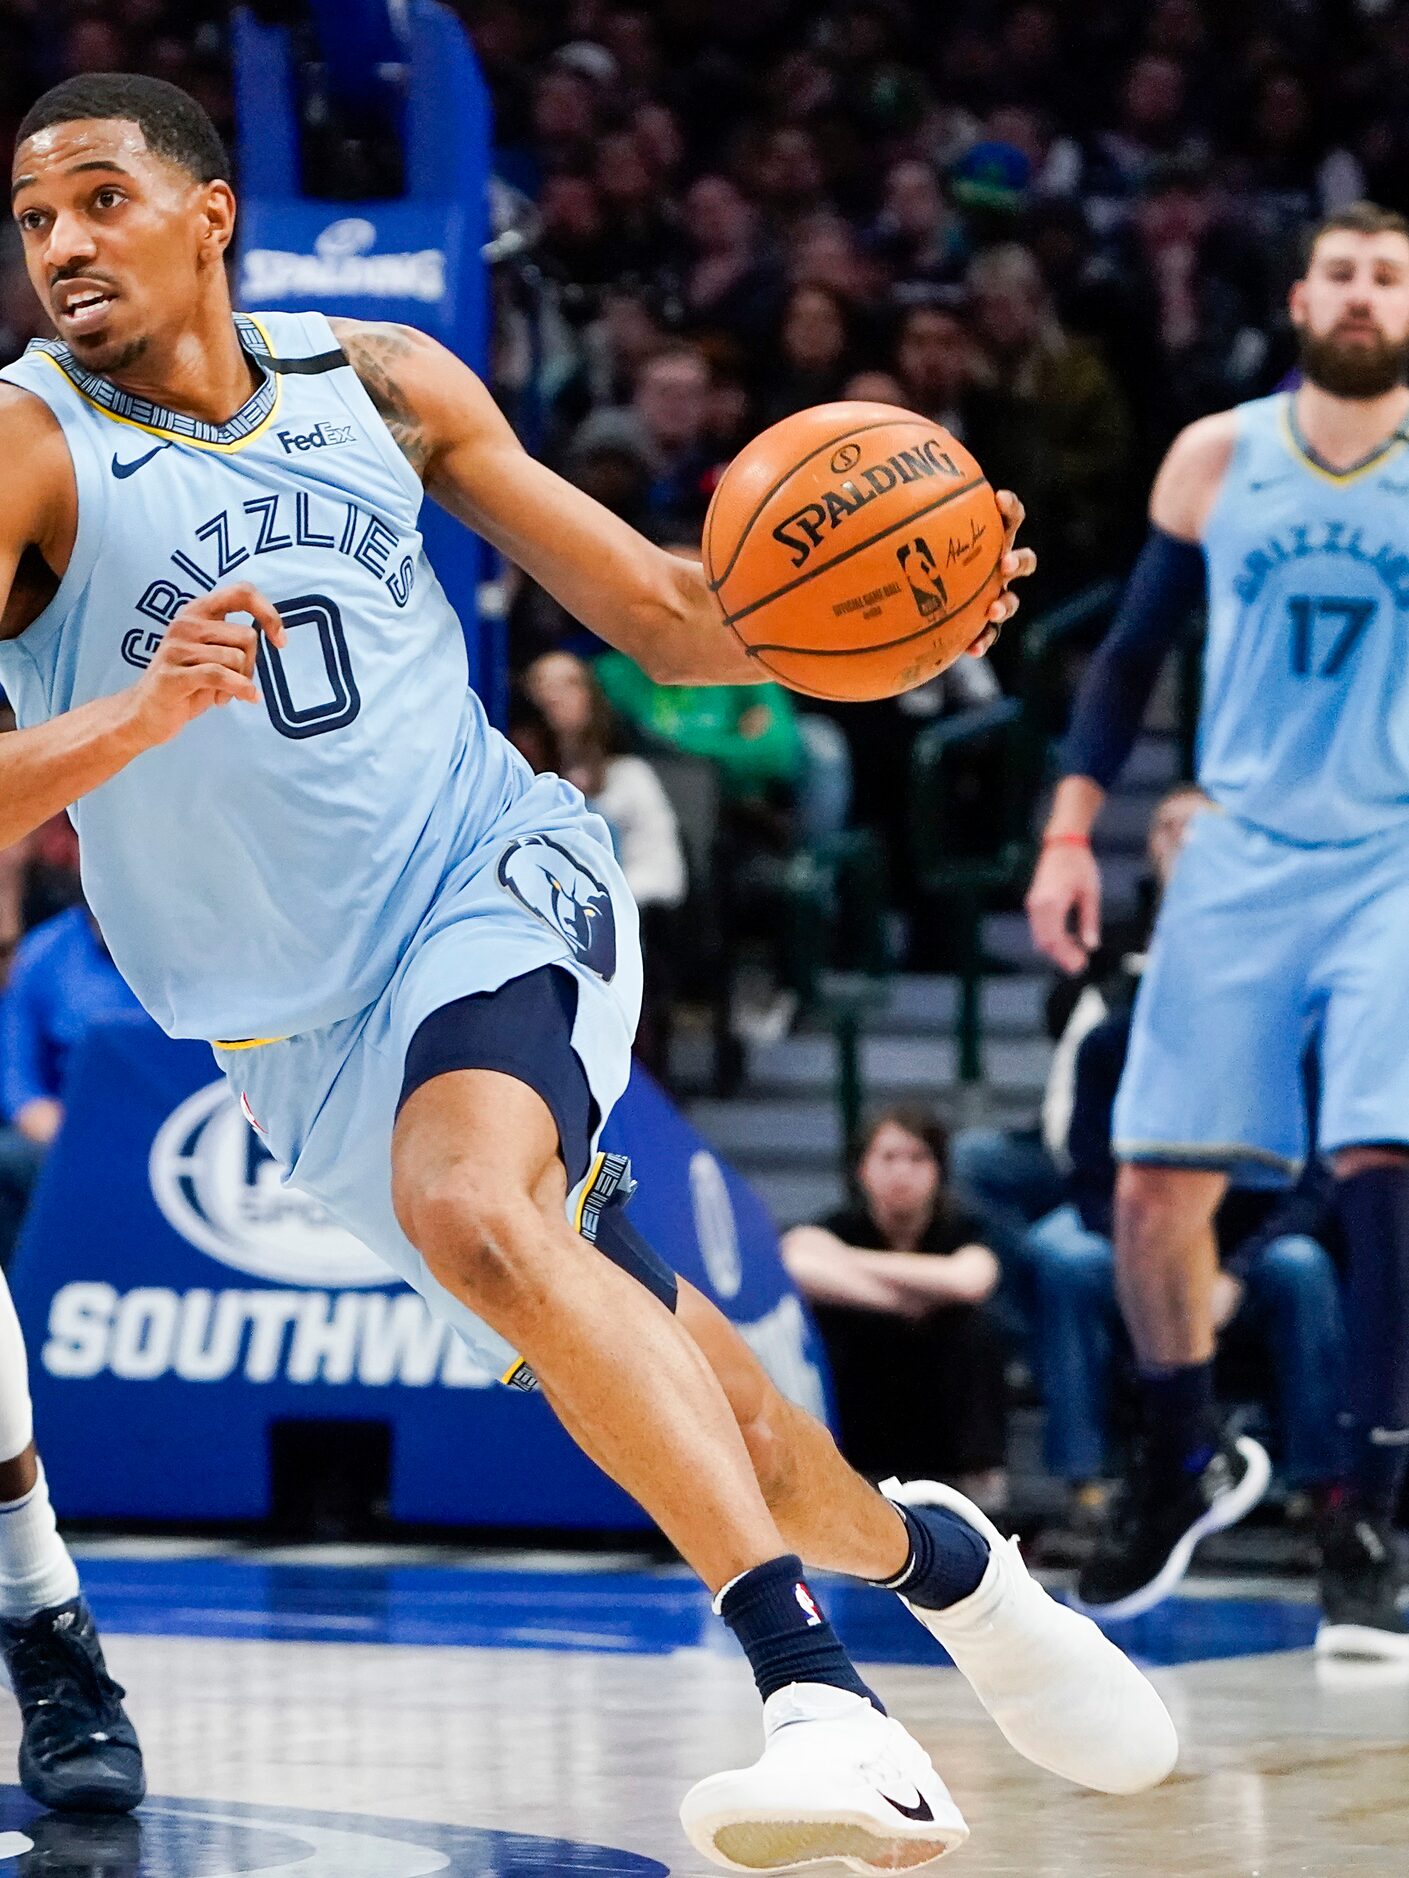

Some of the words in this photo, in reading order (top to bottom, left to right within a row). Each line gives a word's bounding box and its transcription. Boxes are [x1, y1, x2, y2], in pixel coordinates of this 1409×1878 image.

[276, 421, 356, 454] FedEx
[772, 439, 962, 568] SPALDING
[121, 491, 415, 669] GRIZZLIES
[1287, 595, 1378, 678] 17
[251, 593, 361, 740] 0
